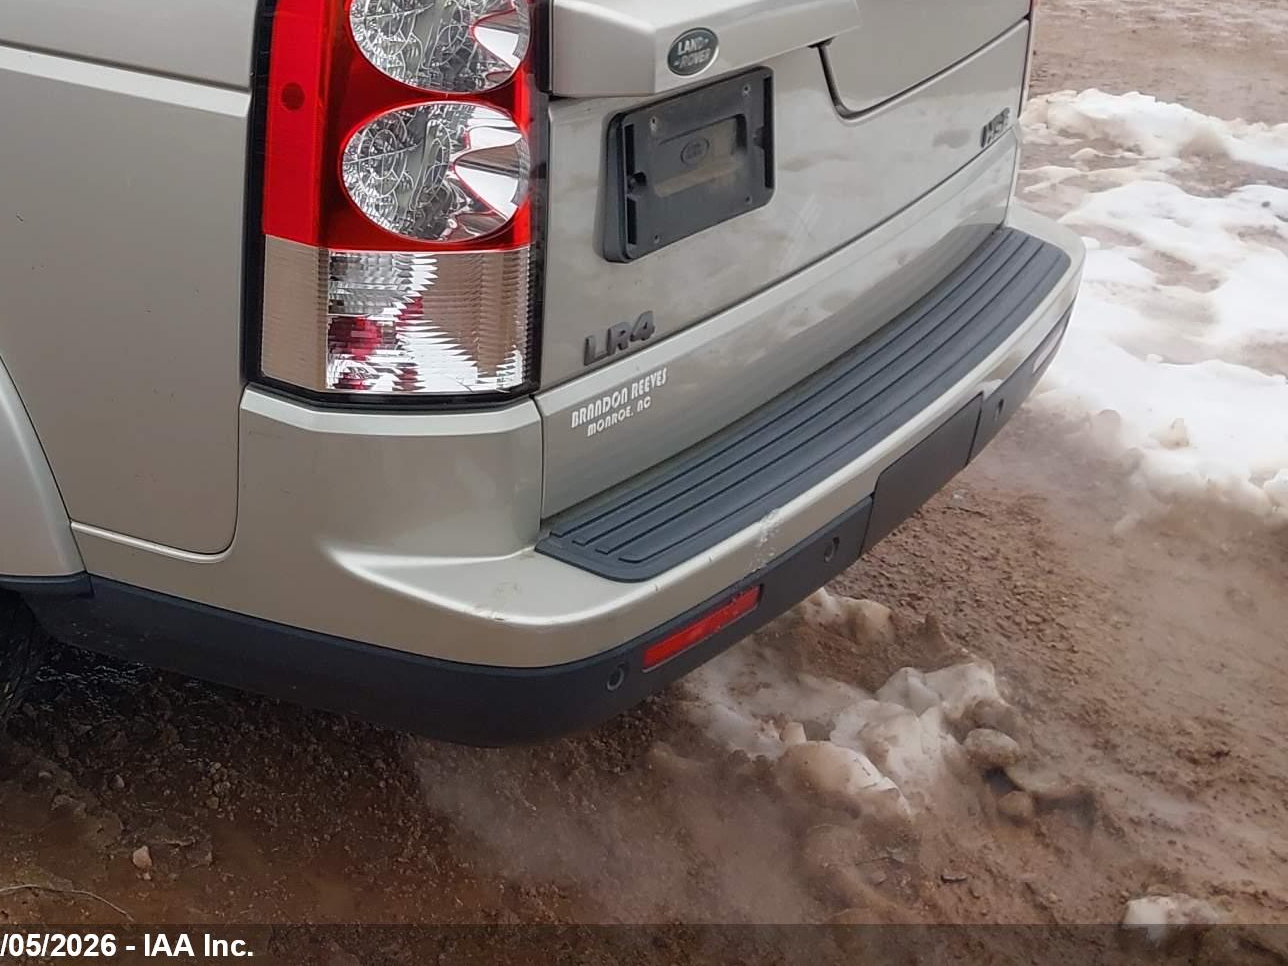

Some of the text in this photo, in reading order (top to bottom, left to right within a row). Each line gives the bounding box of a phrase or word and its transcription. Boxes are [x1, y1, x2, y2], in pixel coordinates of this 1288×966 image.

[678, 36, 704, 55] LAND
[583, 310, 655, 366] LR4
[571, 367, 667, 428] BRANDON REEVES
[636, 396, 651, 412] NC
